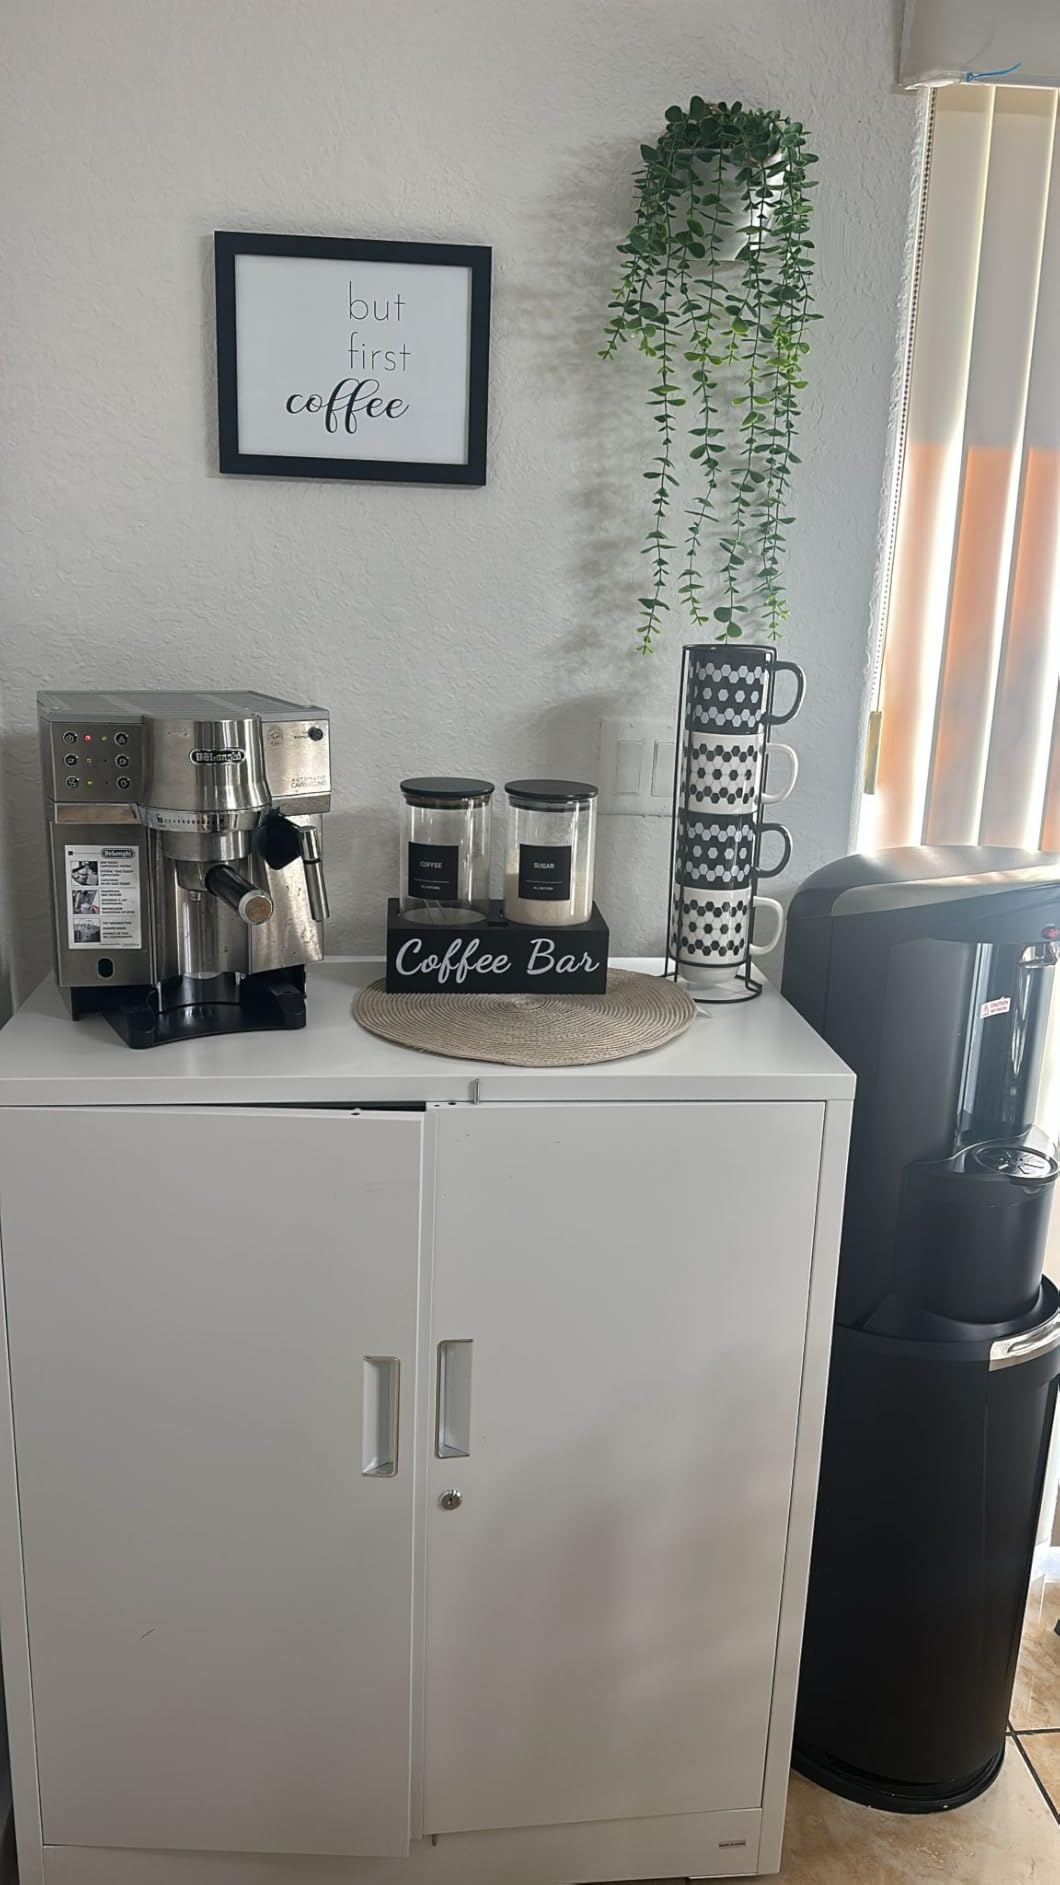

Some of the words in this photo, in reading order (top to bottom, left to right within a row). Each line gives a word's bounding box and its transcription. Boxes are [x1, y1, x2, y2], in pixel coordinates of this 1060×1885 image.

[349, 281, 406, 321] but
[348, 332, 411, 371] first
[286, 378, 409, 434] coffee
[419, 861, 443, 869] COFFEE
[395, 938, 511, 984] Coffee
[526, 938, 600, 975] Bar
